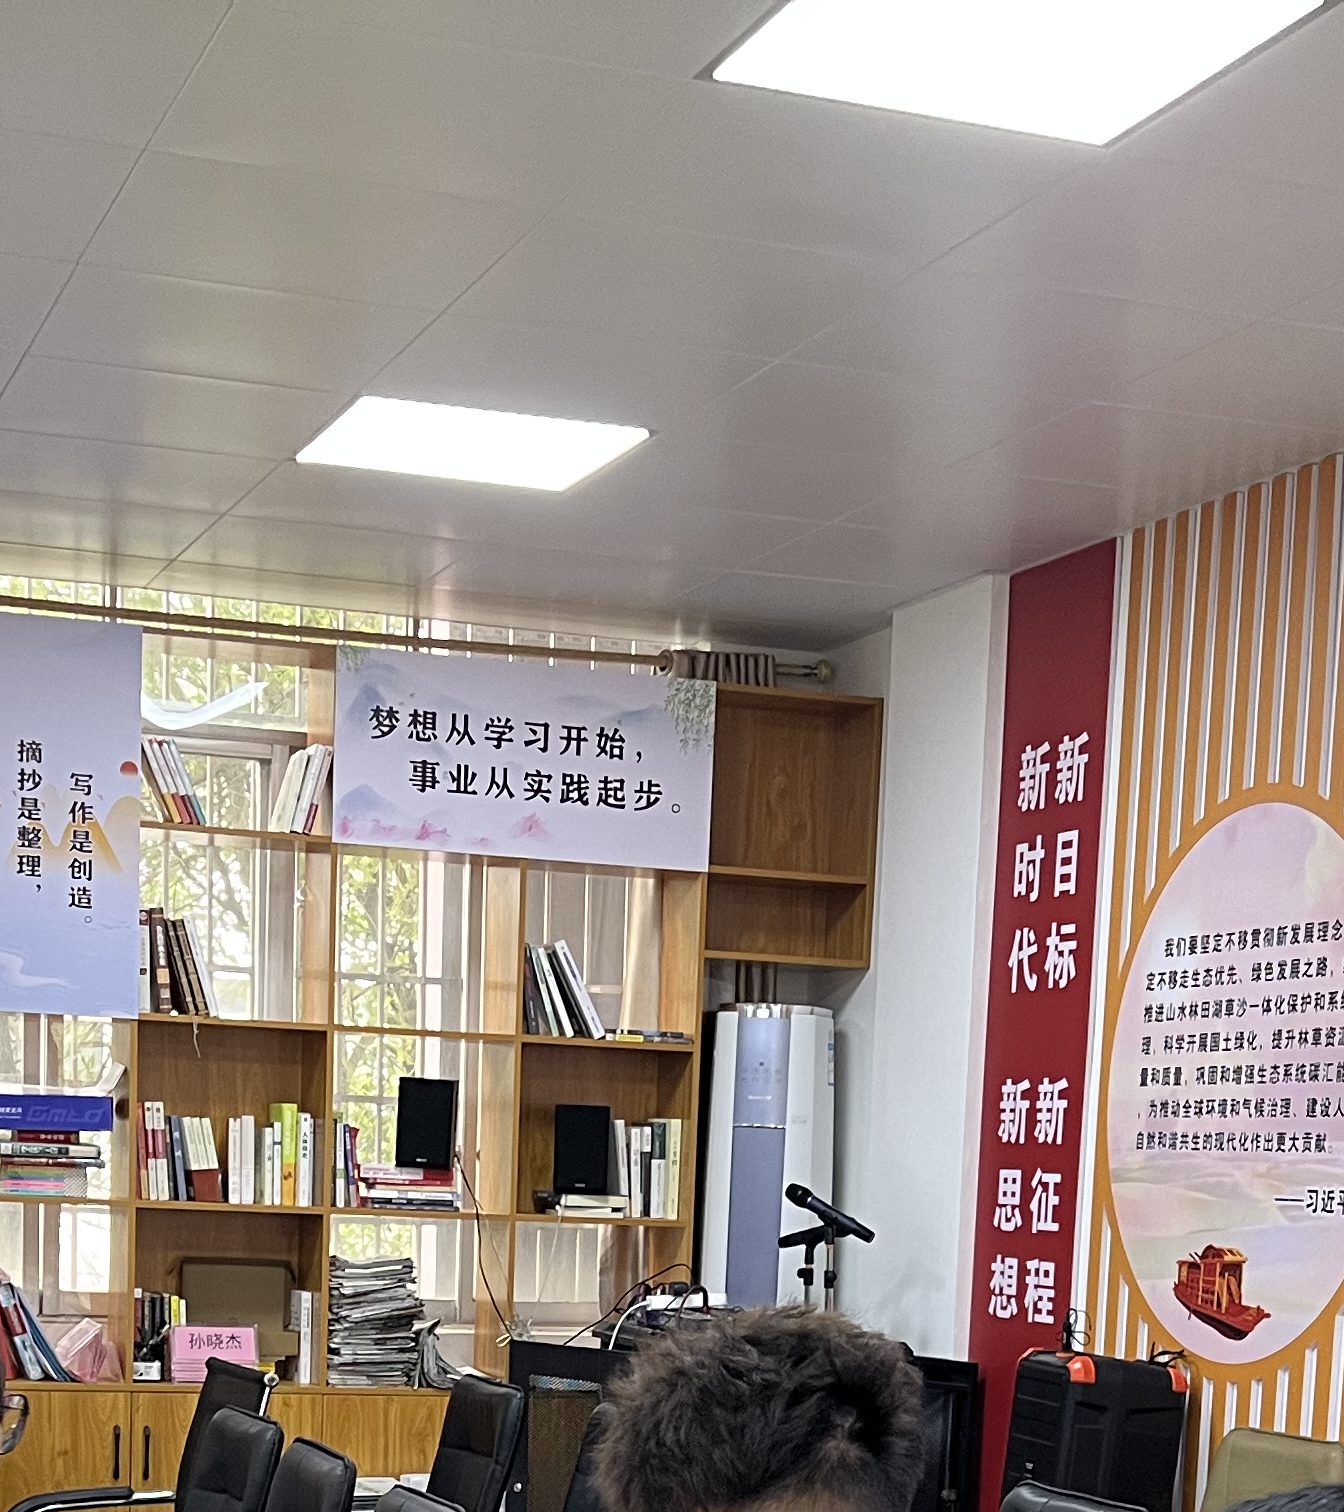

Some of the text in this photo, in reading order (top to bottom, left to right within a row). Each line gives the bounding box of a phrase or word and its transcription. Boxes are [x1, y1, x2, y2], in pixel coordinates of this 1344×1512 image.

[369, 705, 645, 764] 梦想从学习开始，
[408, 758, 681, 815] 事业从实践起步。
[17, 739, 43, 893] 摘抄是整理，
[68, 772, 94, 924] 写作是创造。
[1136, 1131, 1333, 1154] 自然和谐共生的现代化作出更大贡献。
[189, 1333, 242, 1349] 孙晓杰
